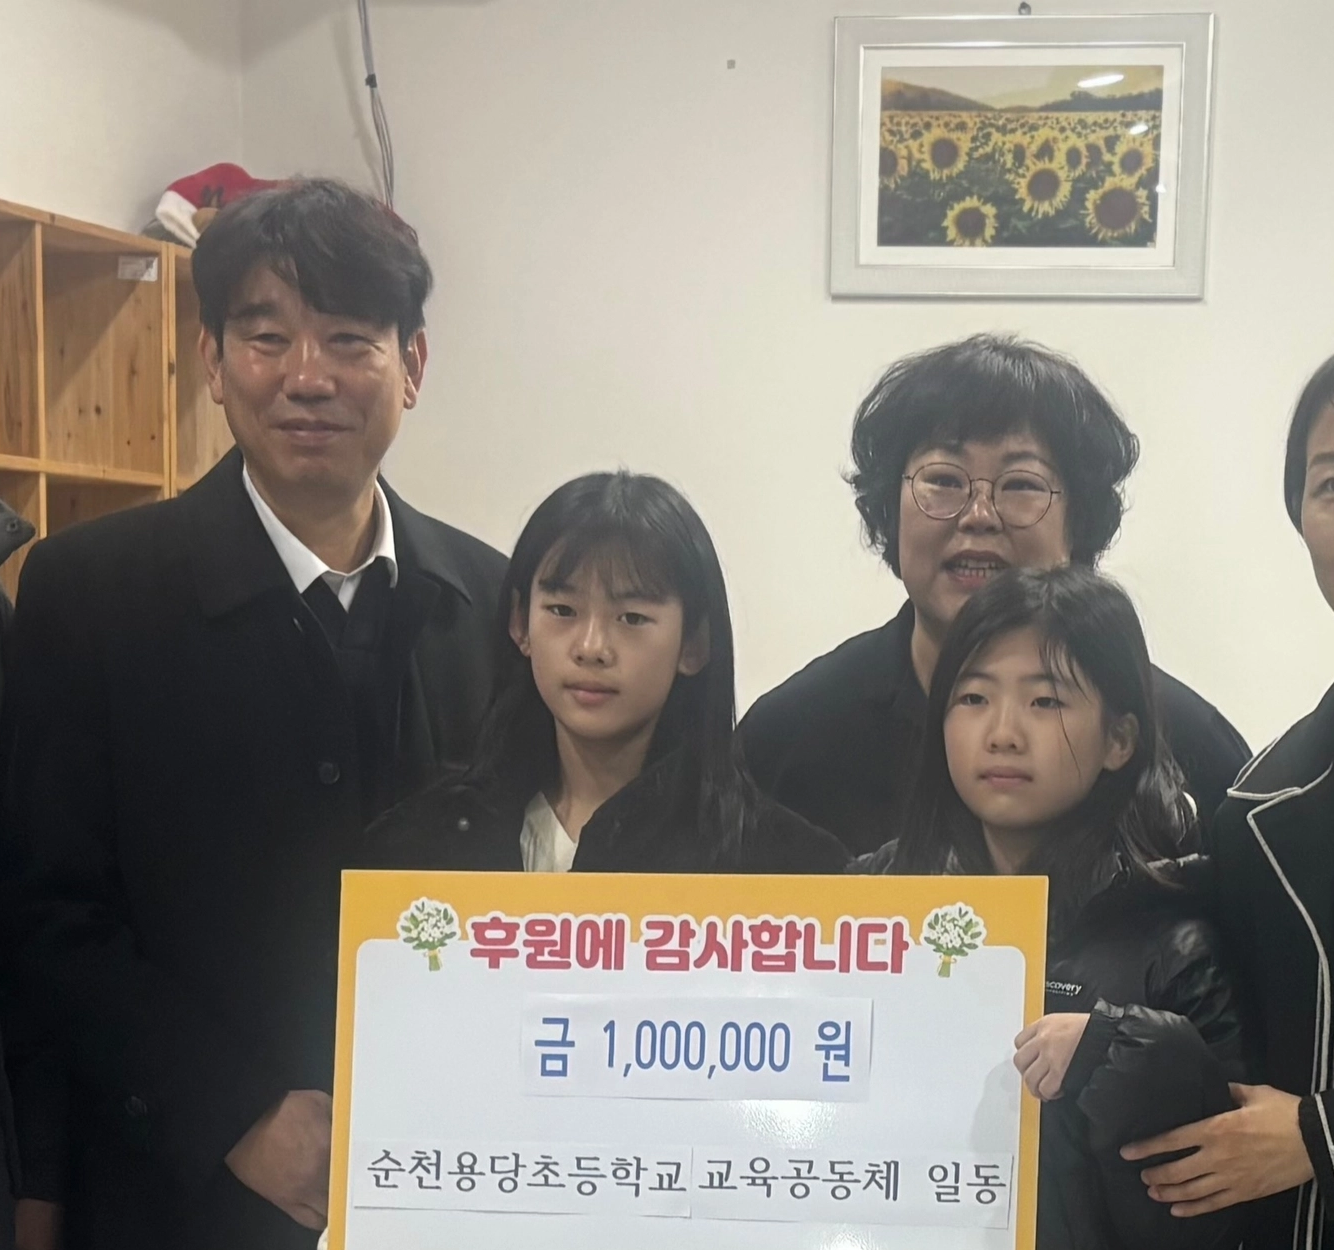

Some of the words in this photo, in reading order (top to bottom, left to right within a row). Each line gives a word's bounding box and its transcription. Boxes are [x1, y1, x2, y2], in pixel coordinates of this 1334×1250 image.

[469, 917, 626, 971] 후원에
[643, 918, 910, 974] 감사합니다
[534, 1016, 576, 1078] 금
[603, 1019, 791, 1079] 1,000,000
[814, 1020, 852, 1082] 원
[367, 1149, 688, 1198] 순천용당초등학교
[698, 1156, 900, 1202] 교육공동체
[927, 1162, 1007, 1205] 일동
